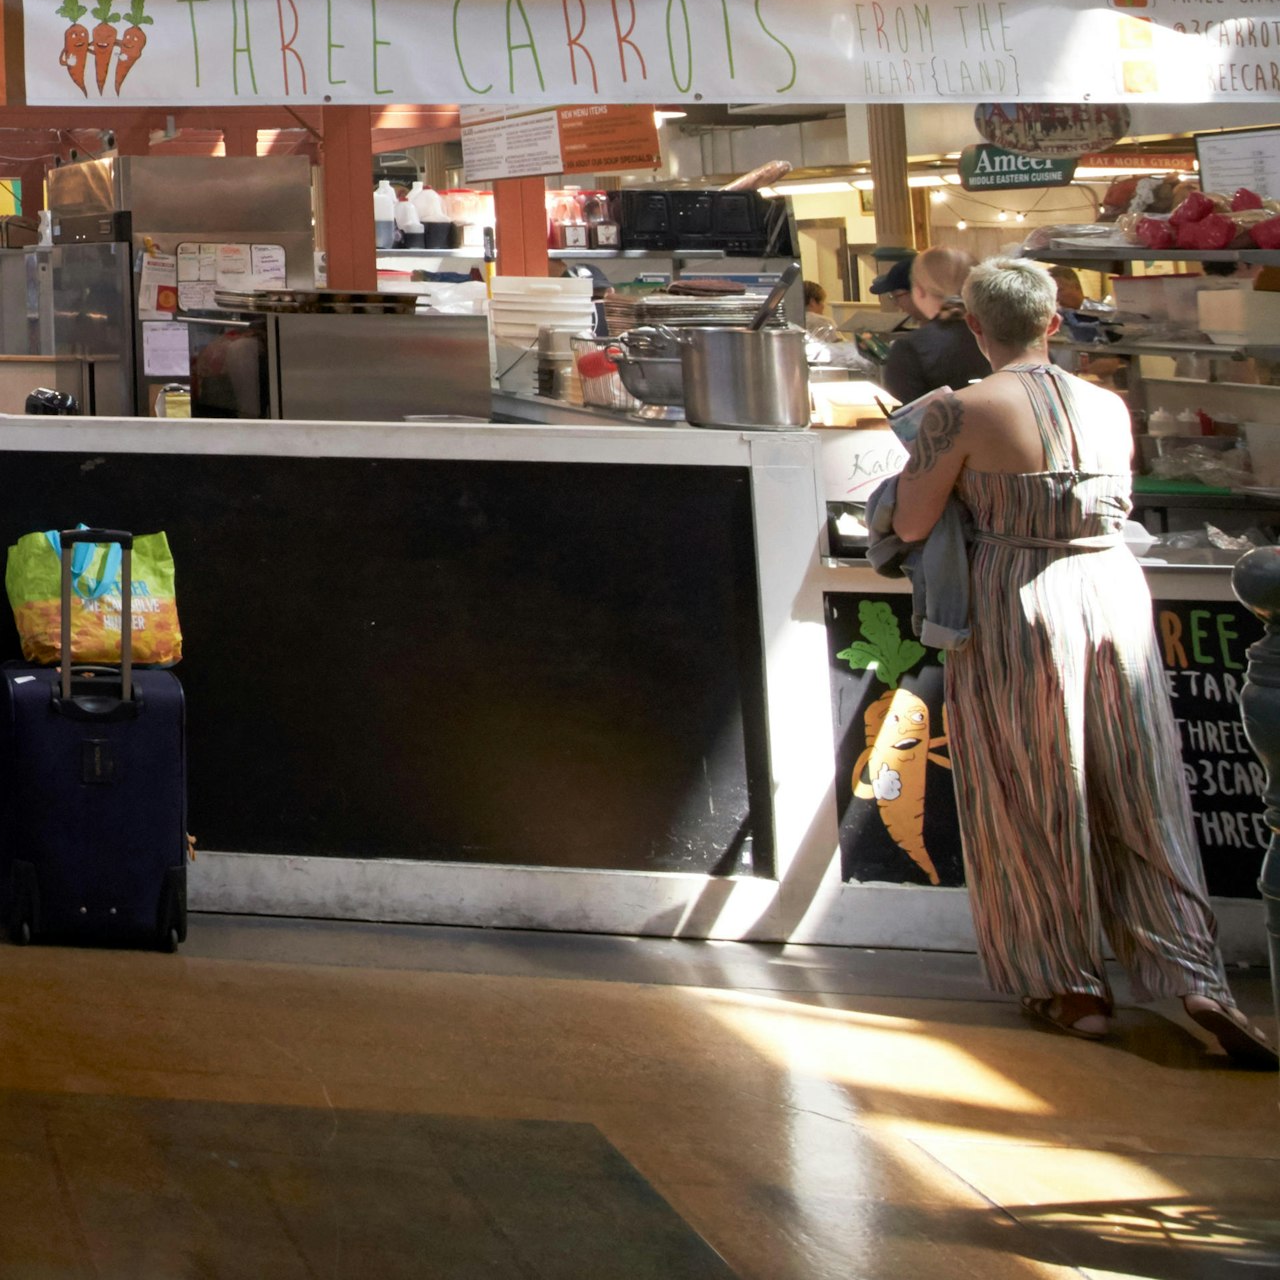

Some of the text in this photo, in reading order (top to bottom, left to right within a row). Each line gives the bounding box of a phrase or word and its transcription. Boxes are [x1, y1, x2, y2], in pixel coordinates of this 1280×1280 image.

[855, 1, 1014, 54] FROM THE
[1089, 156, 1188, 167] EAT MORE GYROS
[969, 170, 1063, 186] MIDDLE EASTERN CUISINE
[848, 448, 903, 480] Kale
